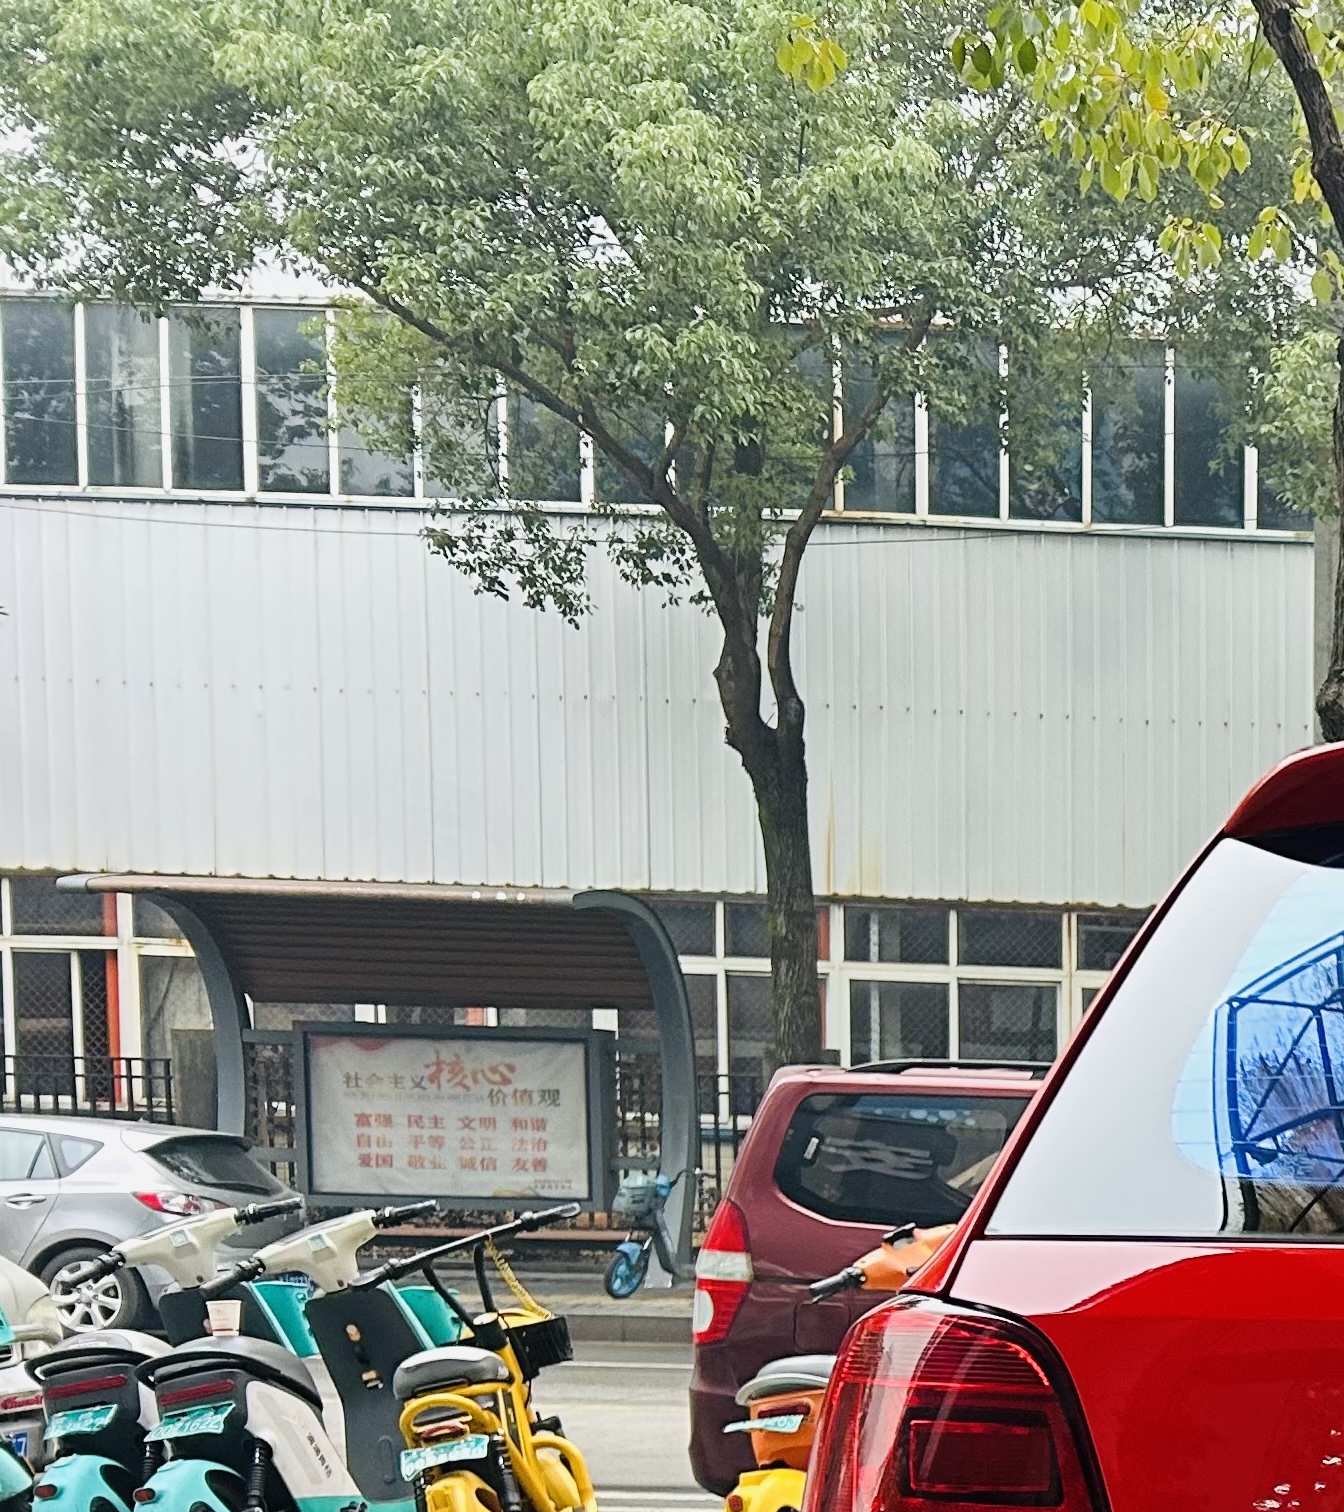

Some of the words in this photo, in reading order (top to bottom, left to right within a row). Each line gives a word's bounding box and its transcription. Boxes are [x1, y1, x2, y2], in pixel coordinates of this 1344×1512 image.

[424, 1051, 517, 1092] 核心
[487, 1087, 562, 1108] 价值观
[354, 1112, 394, 1129] 富强
[406, 1114, 446, 1131] 民主
[459, 1115, 498, 1132] 文明
[511, 1116, 548, 1133] 和谐
[355, 1133, 393, 1150] 自由
[408, 1134, 446, 1150] 平等
[459, 1136, 499, 1152] 公正
[511, 1136, 549, 1153] 法治
[357, 1153, 394, 1170] 爱国
[407, 1154, 448, 1171] 敬业
[459, 1155, 498, 1172] 诚信
[511, 1156, 549, 1174] 友善
